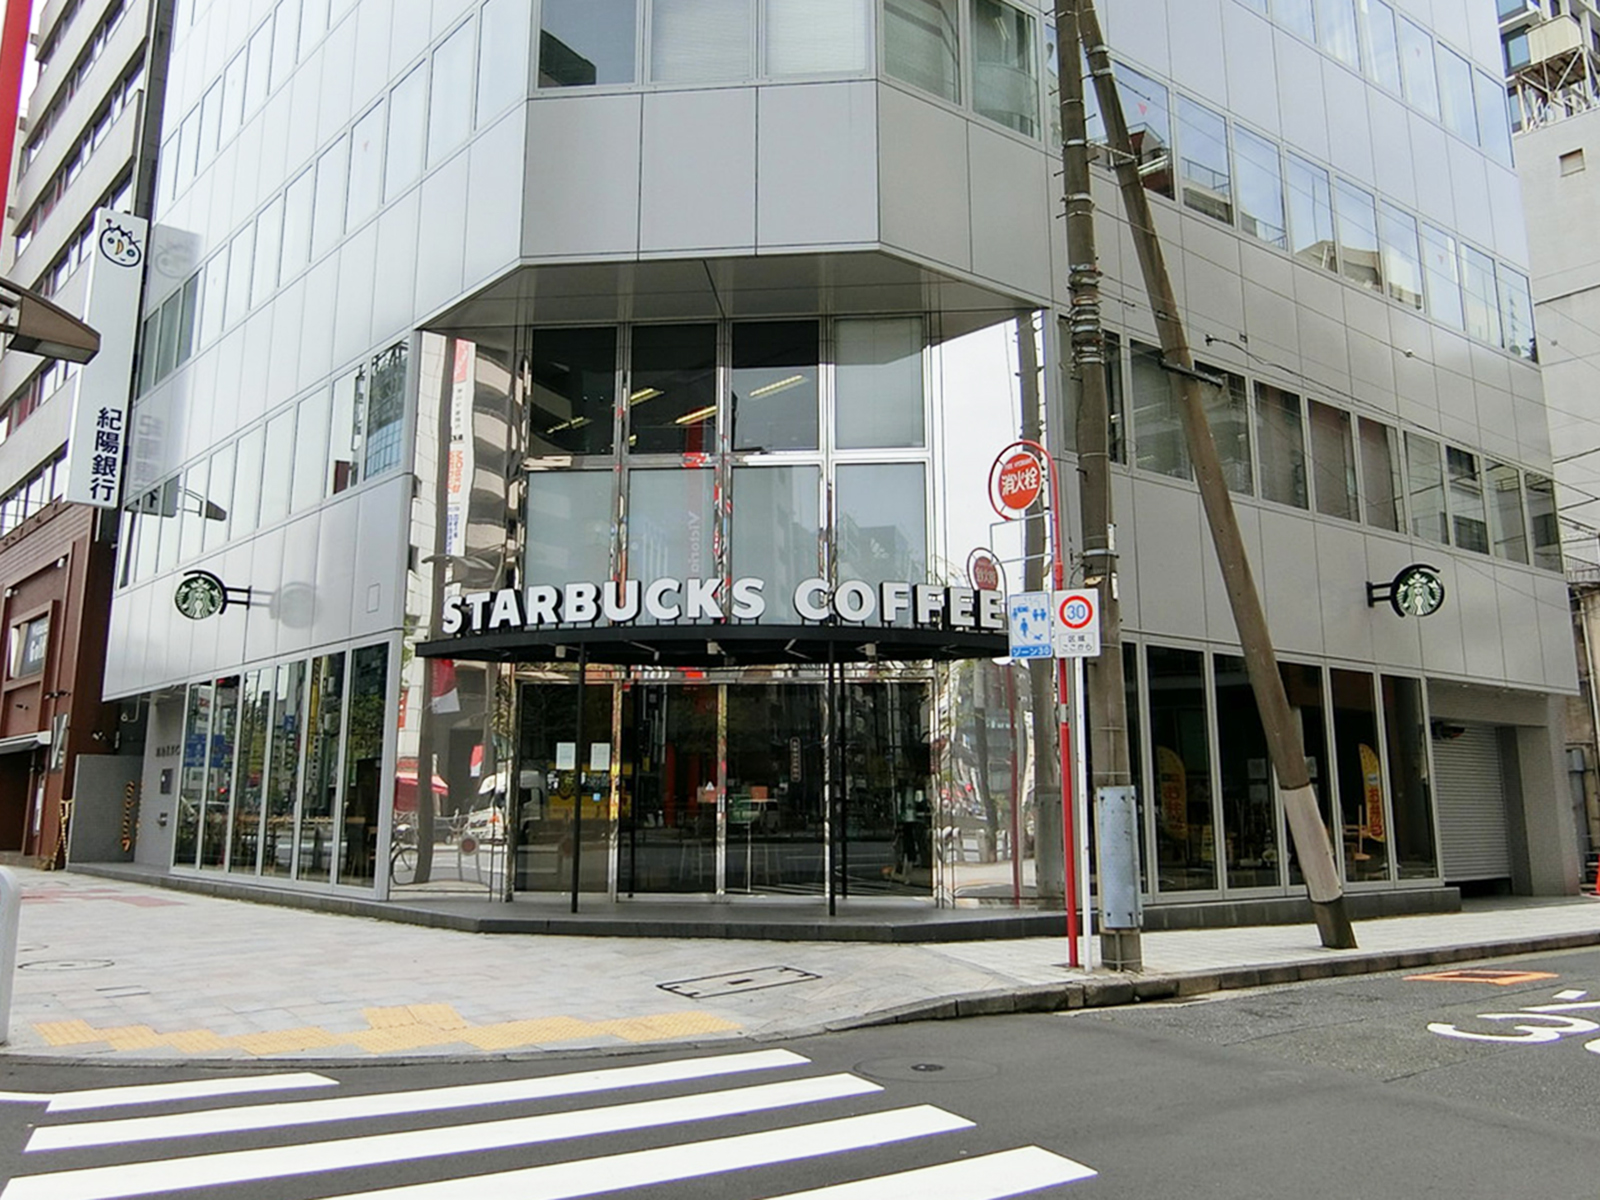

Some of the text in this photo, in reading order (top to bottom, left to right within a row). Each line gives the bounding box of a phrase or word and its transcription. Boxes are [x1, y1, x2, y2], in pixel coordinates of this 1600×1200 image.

[90, 407, 122, 501] 紀陽銀行
[1001, 466, 1038, 496] 消火栓
[442, 577, 767, 634] STARBUCKS
[794, 579, 1003, 629] COFFEE
[1067, 605, 1086, 620] 30
[1427, 1012, 1600, 1054] 3
